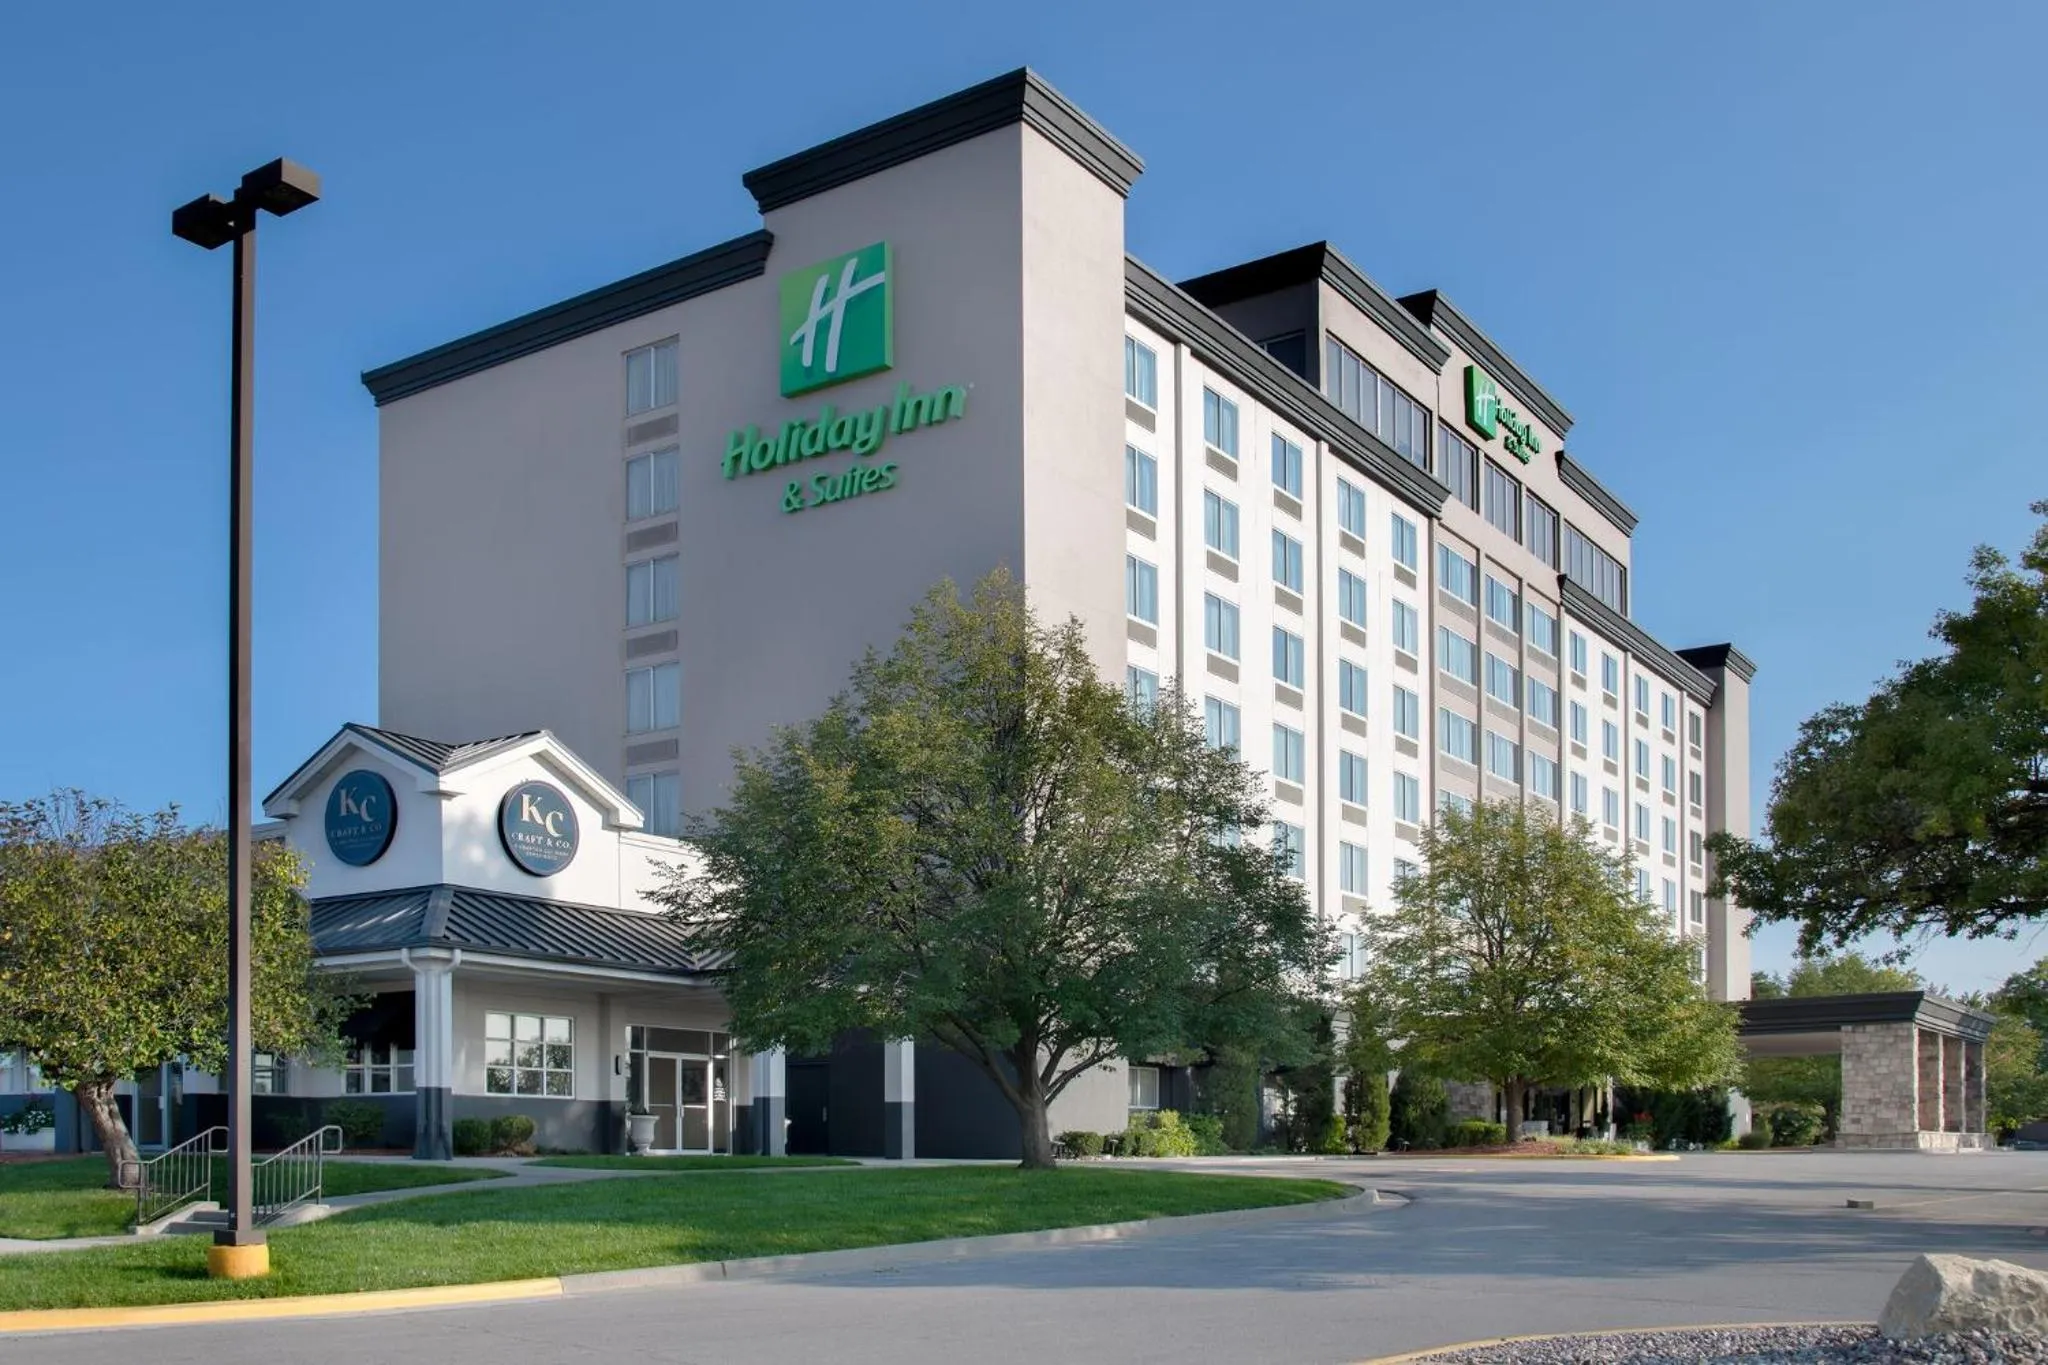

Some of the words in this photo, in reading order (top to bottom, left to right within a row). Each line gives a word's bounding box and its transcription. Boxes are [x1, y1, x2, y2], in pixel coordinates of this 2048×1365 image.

[721, 404, 887, 480] Holiday
[890, 382, 967, 435] Inn
[780, 479, 804, 514] &
[808, 462, 898, 507] Suites
[339, 787, 376, 821] KC
[521, 794, 564, 837] KC
[511, 833, 543, 845] CRAFT
